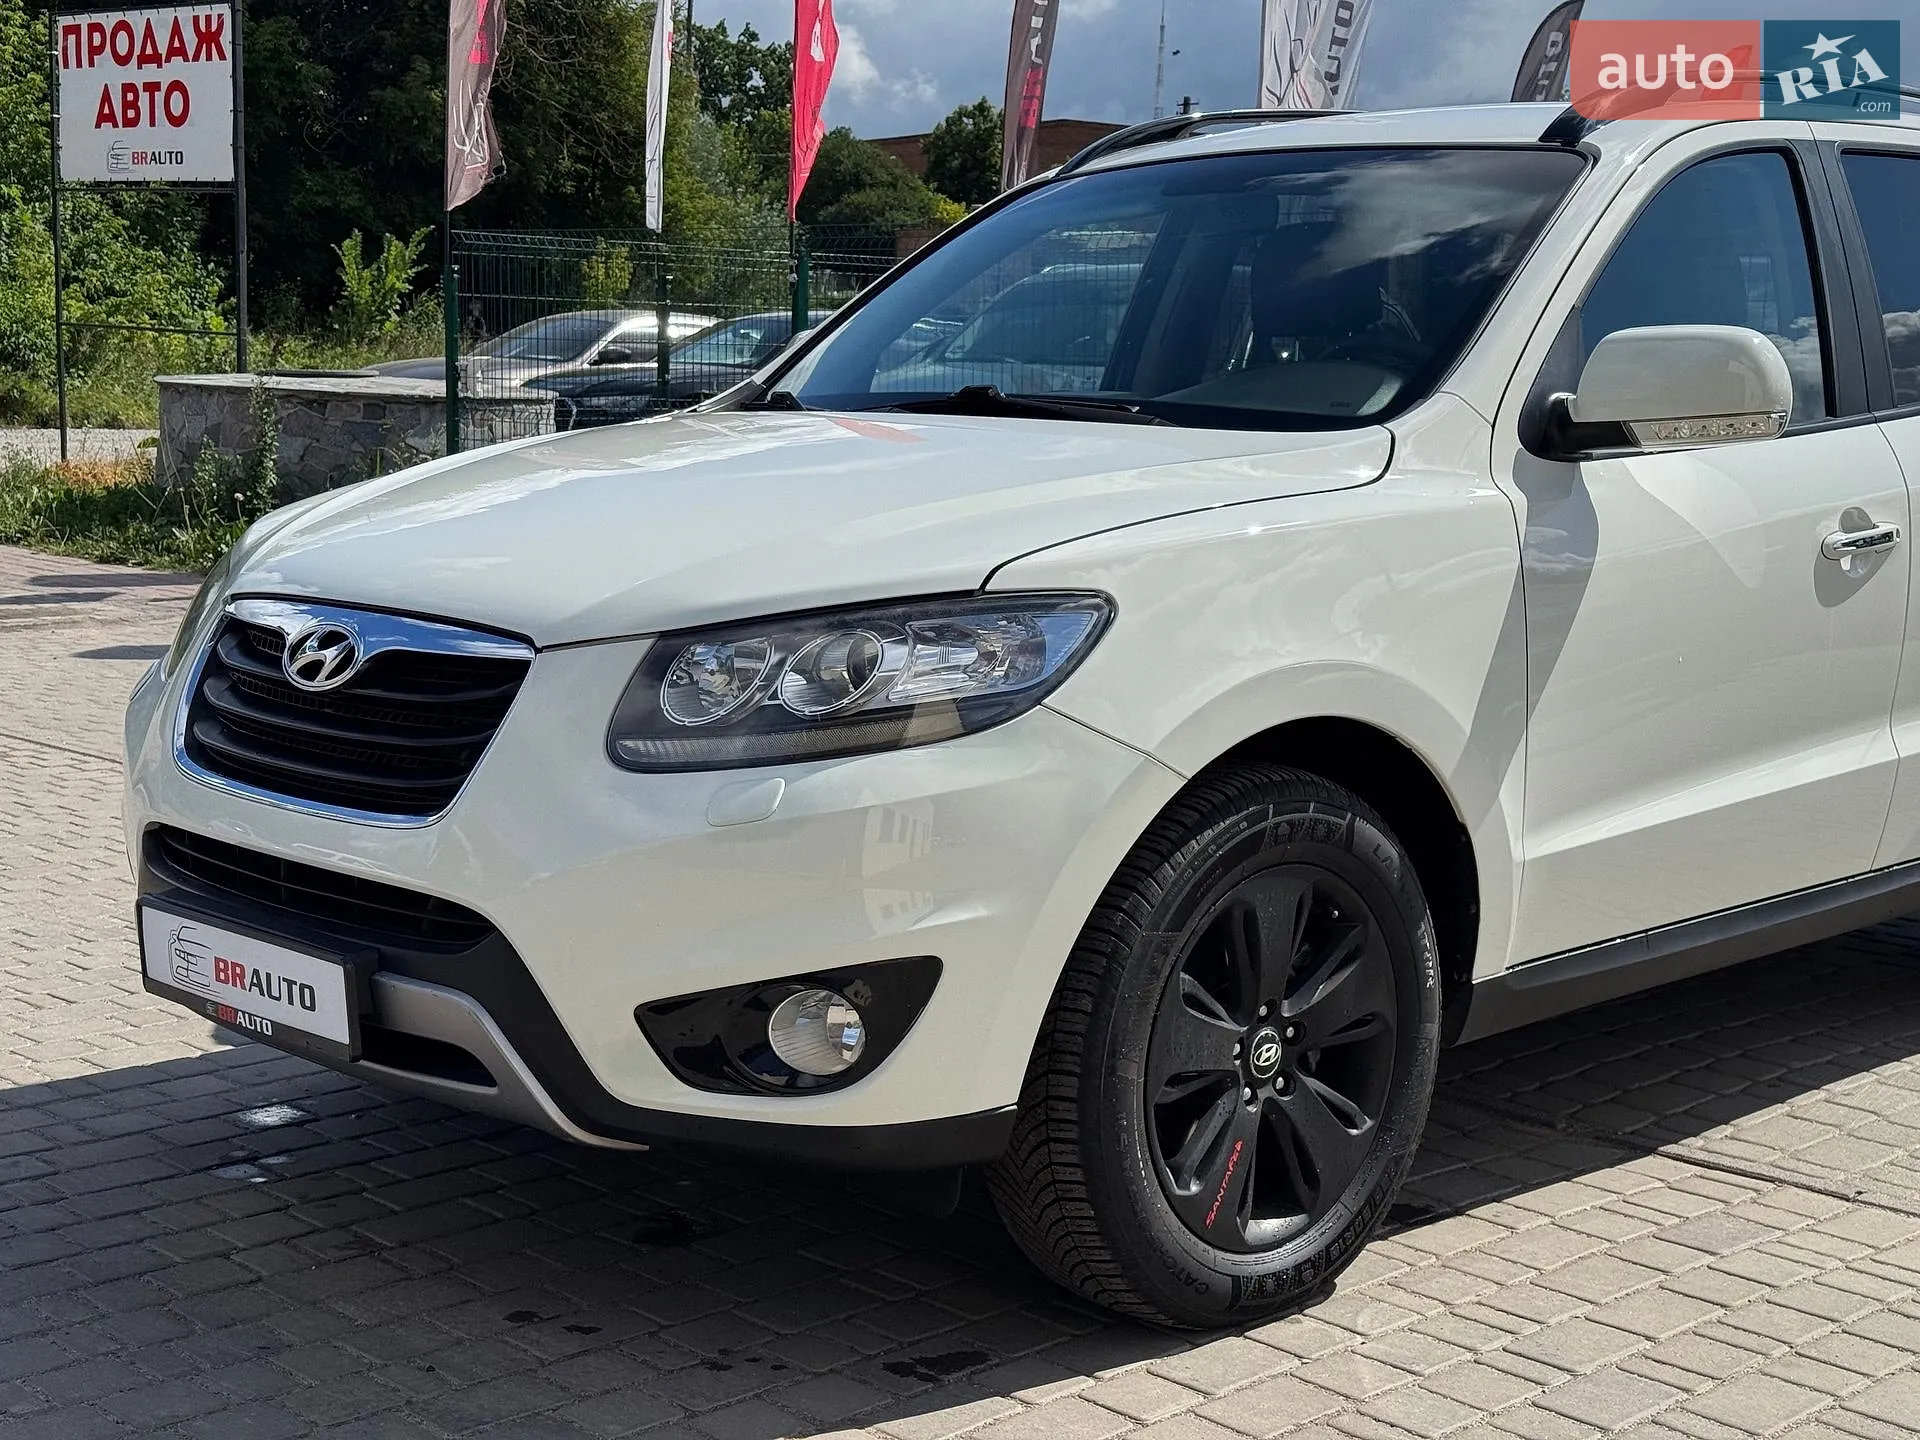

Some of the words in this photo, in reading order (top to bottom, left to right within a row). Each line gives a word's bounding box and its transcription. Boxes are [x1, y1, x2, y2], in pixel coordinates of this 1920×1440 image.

[61, 14, 228, 70] ПРОДАЖ
[94, 79, 191, 130] АВТО
[131, 150, 184, 166] BRAUTO
[213, 955, 317, 1013] BRAUTO
[216, 1003, 273, 1037] BRAUTO
